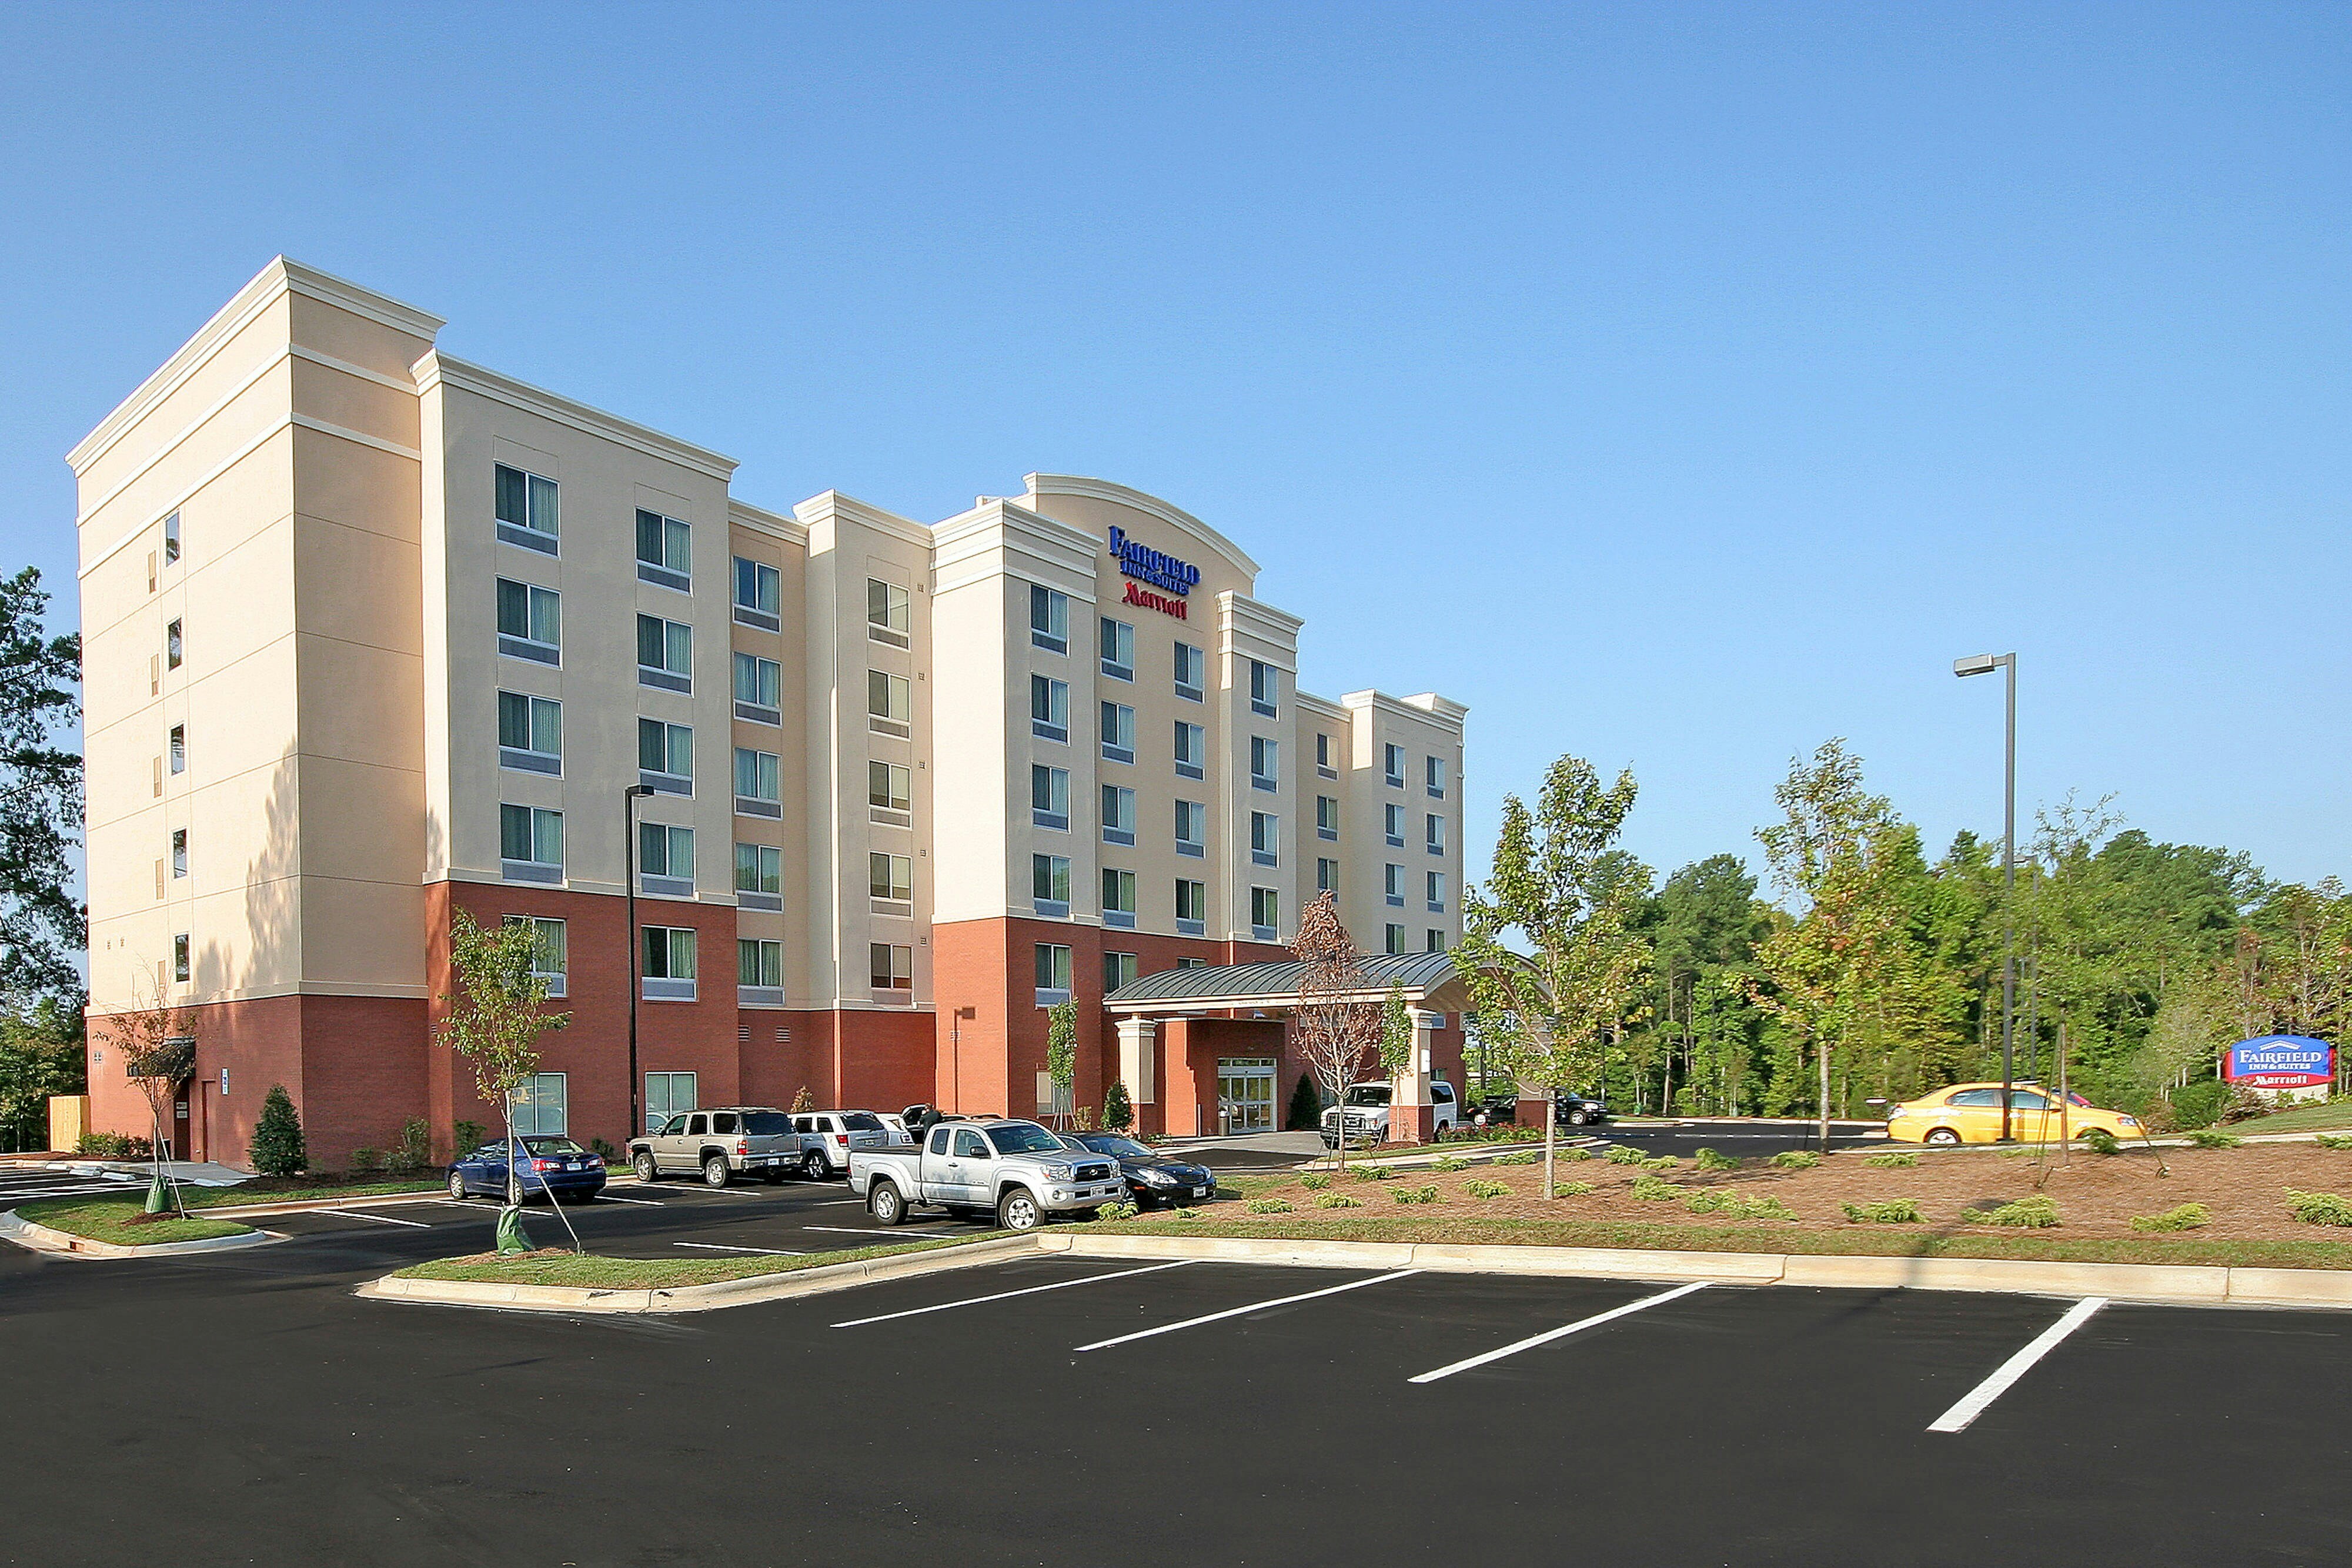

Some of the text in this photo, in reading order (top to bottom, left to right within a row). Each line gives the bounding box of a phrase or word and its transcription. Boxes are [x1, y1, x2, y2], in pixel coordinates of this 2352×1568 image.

[1108, 525, 1201, 585] FAIRFIELD
[1120, 560, 1145, 580] INN
[1155, 573, 1190, 596] SUITES
[1122, 581, 1187, 620] Marriott
[2239, 1049, 2323, 1064] FAIRFIELD
[2253, 1075, 2308, 1086] Marriott
